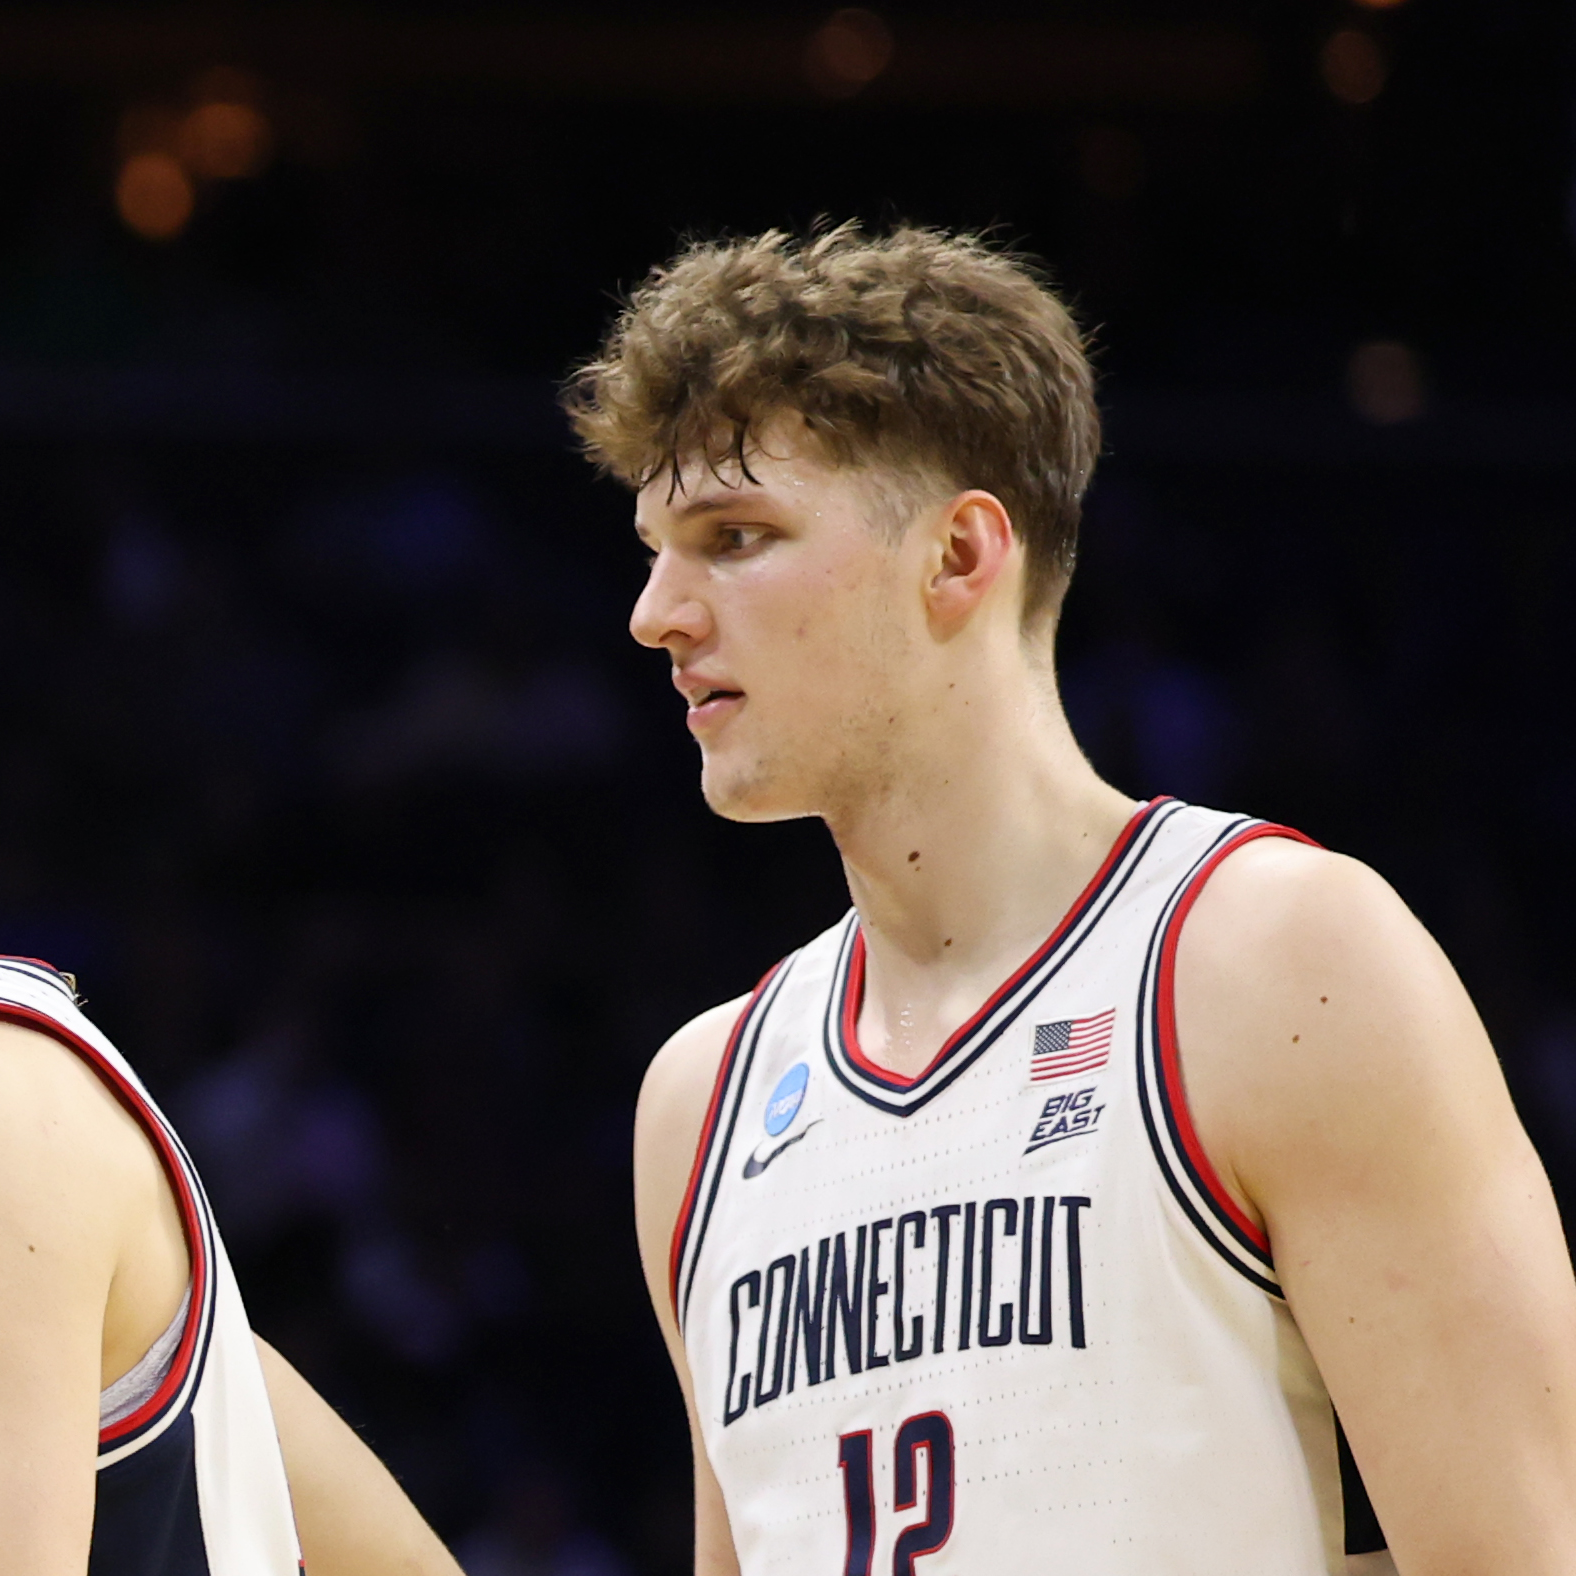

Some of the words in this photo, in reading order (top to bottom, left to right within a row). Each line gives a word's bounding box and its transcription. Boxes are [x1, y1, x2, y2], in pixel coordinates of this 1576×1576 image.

[1040, 1086, 1097, 1119] BIG
[1029, 1103, 1106, 1142] EAST
[723, 1196, 1092, 1428] CONNECTICUT
